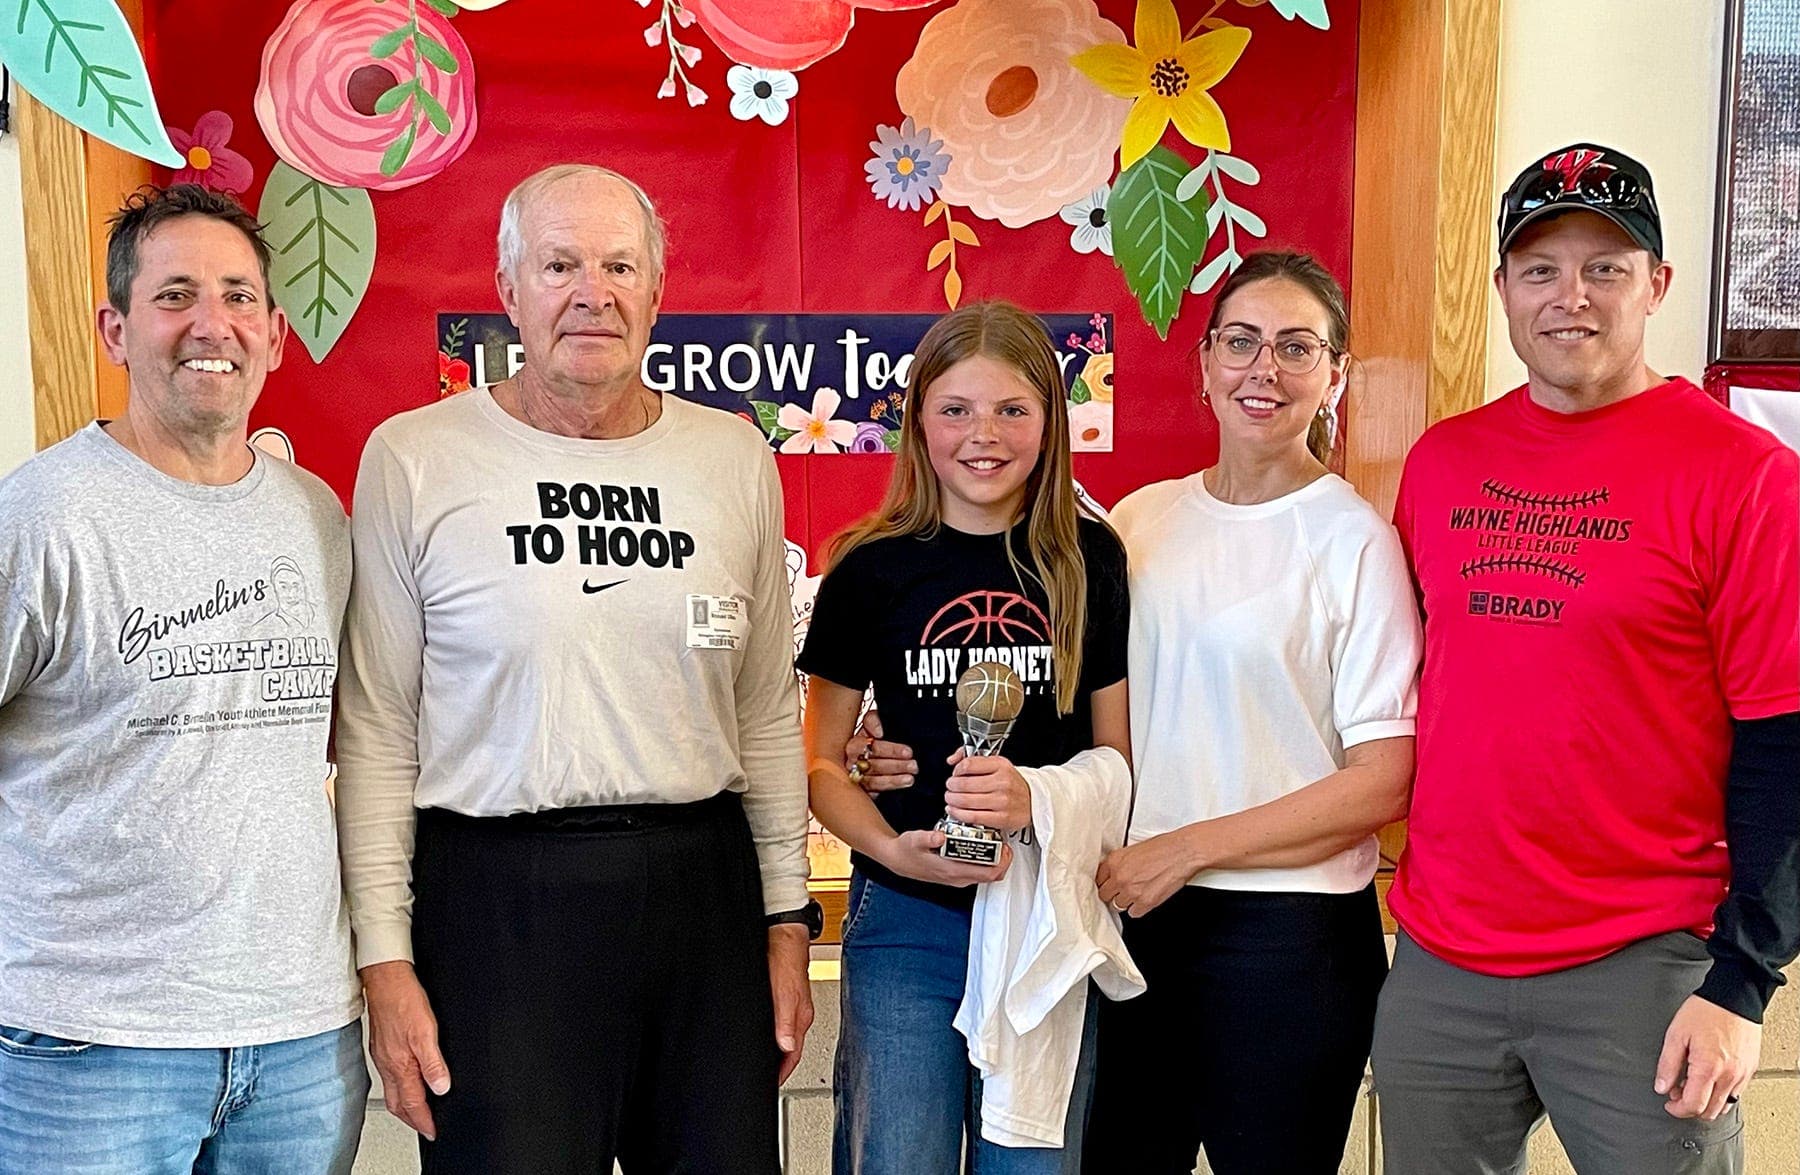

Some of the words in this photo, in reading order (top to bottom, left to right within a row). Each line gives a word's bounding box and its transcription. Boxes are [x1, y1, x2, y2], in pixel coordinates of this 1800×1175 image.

[640, 343, 816, 392] GROW
[536, 481, 662, 525] BORN
[1449, 507, 1514, 532] WAYNE
[1514, 511, 1633, 542] HIGHLANDS
[505, 523, 565, 565] TO
[577, 525, 696, 570] HOOP
[1477, 534, 1524, 551] LITTLE
[1526, 538, 1580, 556] LEAGUE
[118, 578, 270, 665] Birmelin's
[1490, 595, 1565, 620] BRADY
[147, 636, 336, 681] BASKETBALL
[905, 647, 961, 686] LADY
